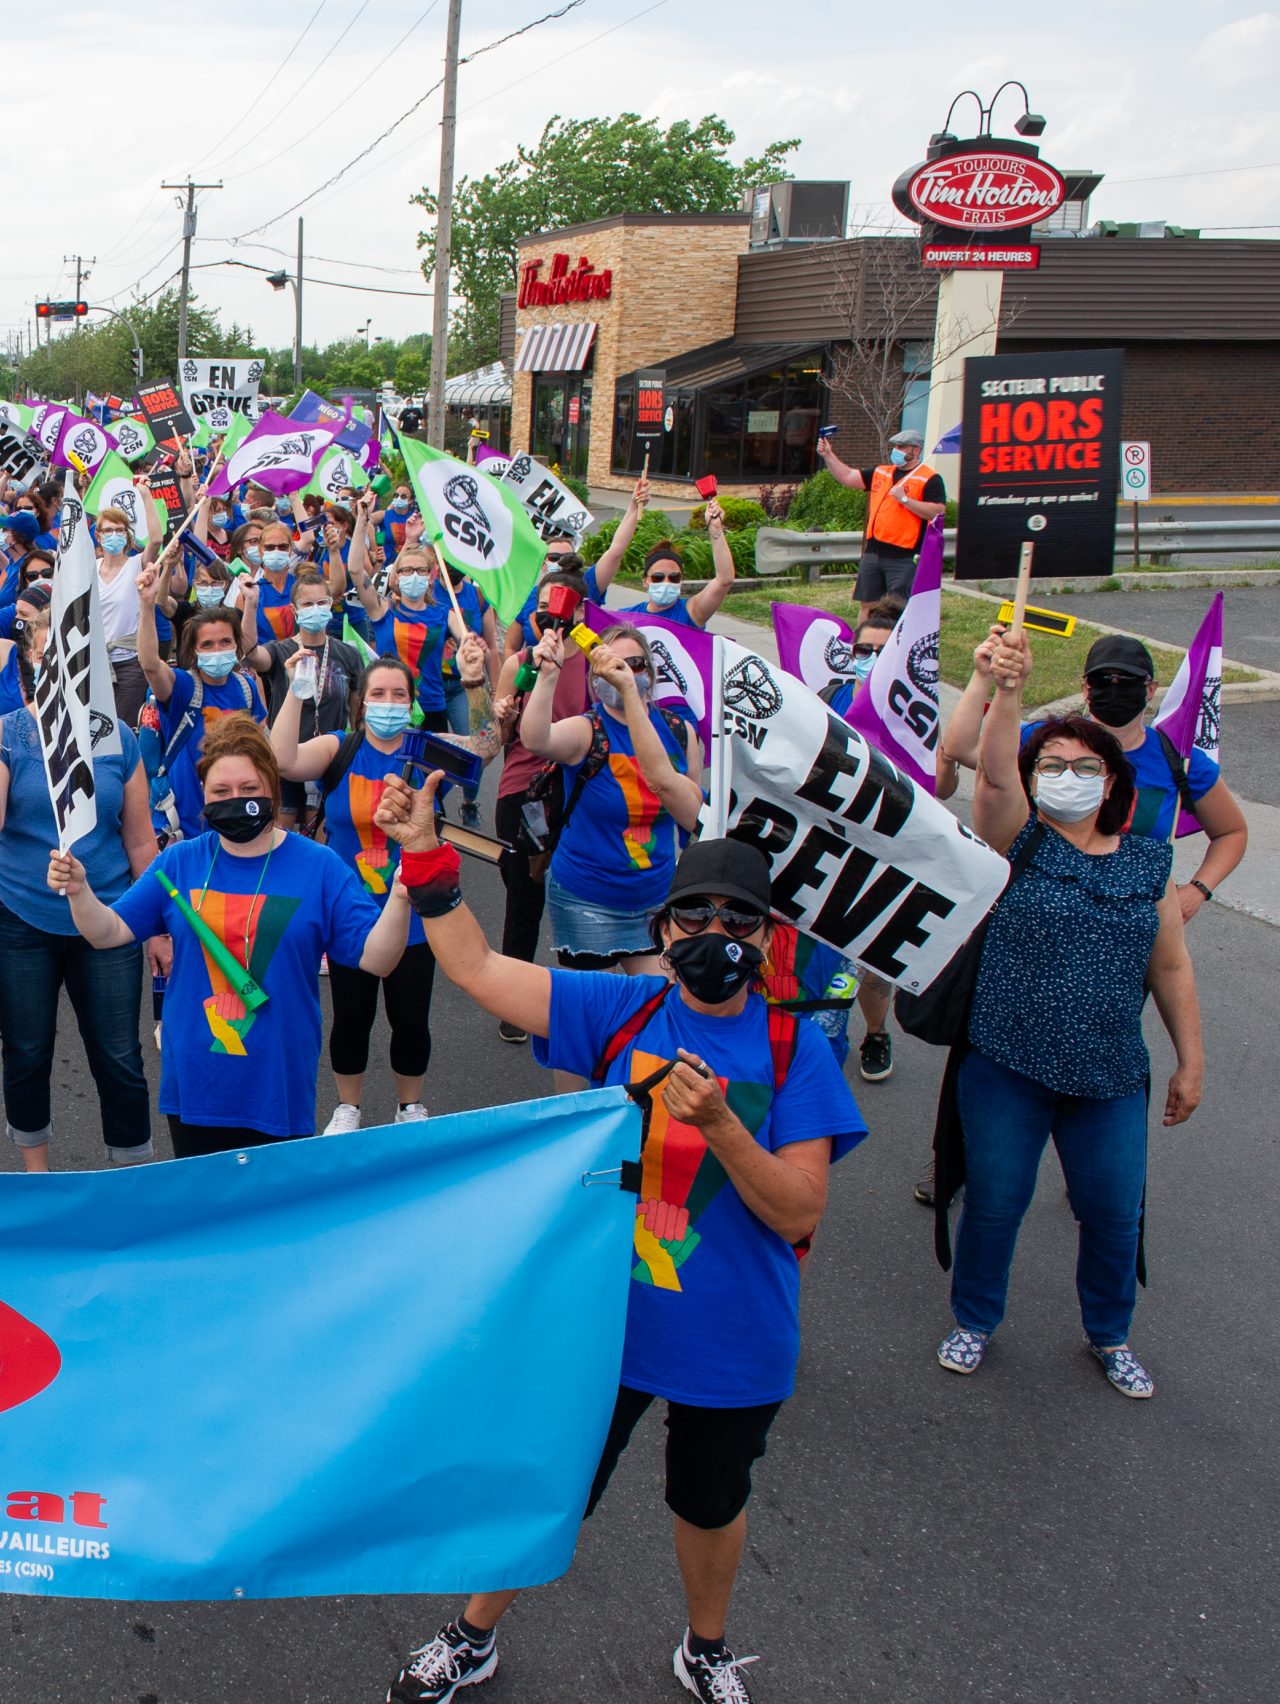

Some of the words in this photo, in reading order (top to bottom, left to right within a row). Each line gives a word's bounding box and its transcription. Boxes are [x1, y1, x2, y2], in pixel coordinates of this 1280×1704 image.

[954, 159, 1027, 175] TOUJOURS
[919, 171, 962, 205] Tim
[965, 171, 1059, 207] Hortons
[962, 210, 1006, 223] FRAIS
[926, 251, 971, 262] OUVERT
[972, 251, 985, 262] 24
[988, 251, 1032, 262] HEURES
[209, 366, 236, 391] EN
[981, 377, 1046, 397] SECTEUR
[1049, 375, 1105, 393] PUBLIC
[141, 387, 176, 408] HORS
[147, 398, 179, 415] SERVICE
[190, 392, 253, 417] GRÈVE
[638, 389, 663, 409] HORS
[317, 403, 339, 419] NÉGO
[638, 410, 663, 422] SERVICE
[980, 398, 1104, 444] HORS
[123, 440, 144, 455] CSN
[979, 442, 1101, 474] SERVICE
[526, 478, 566, 519] EN
[444, 513, 495, 560] CSN
[794, 712, 915, 838] EN
[712, 785, 958, 980] RÈVE
[14, 1560, 55, 1581] (CSN)
